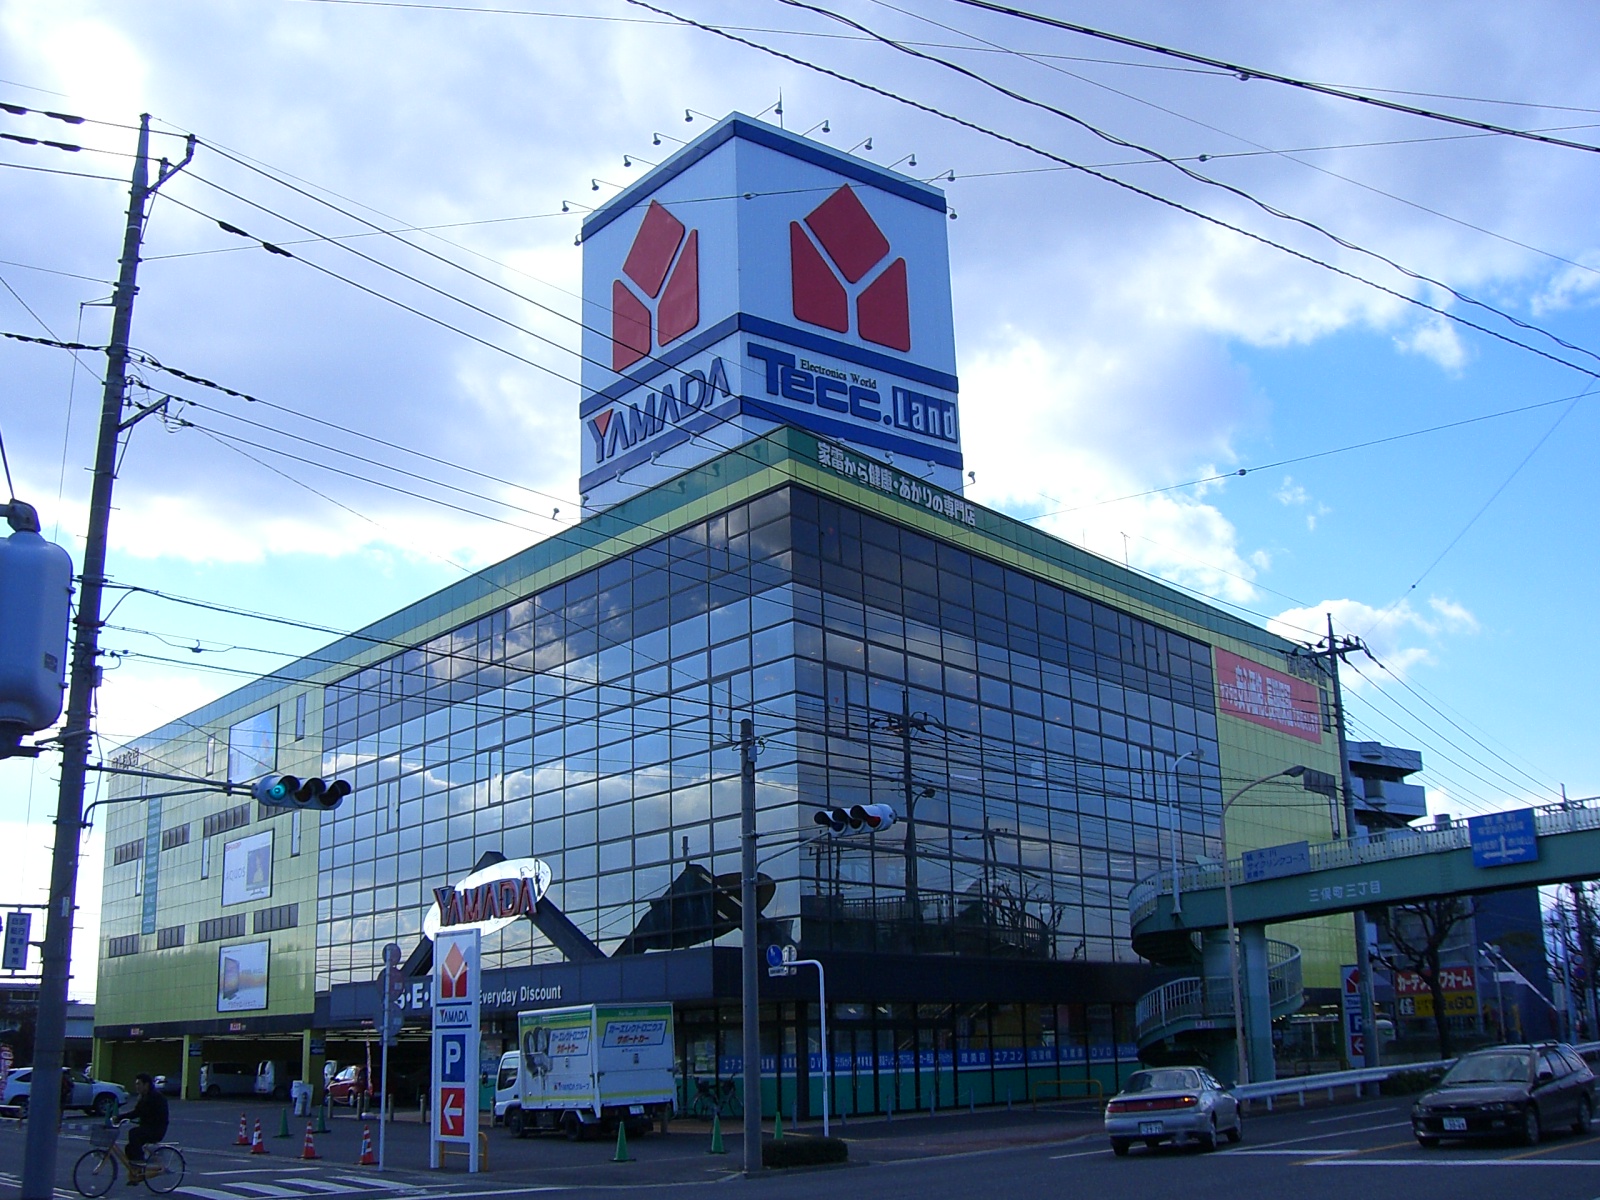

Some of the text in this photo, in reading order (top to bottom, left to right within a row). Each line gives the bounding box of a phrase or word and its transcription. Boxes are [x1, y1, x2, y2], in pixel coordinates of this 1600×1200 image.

[800, 359, 877, 389] Electronics World
[587, 356, 732, 464] YAMADA
[817, 441, 977, 527] 家電から健康・あかりの専門店
[432, 877, 537, 927] YAMADA
[1309, 880, 1381, 902] 三俣町三丁目
[520, 985, 562, 1001] Discount
[440, 1009, 469, 1022] YAMADA
[445, 1041, 461, 1075] P
[994, 1051, 1024, 1061] エアコン
